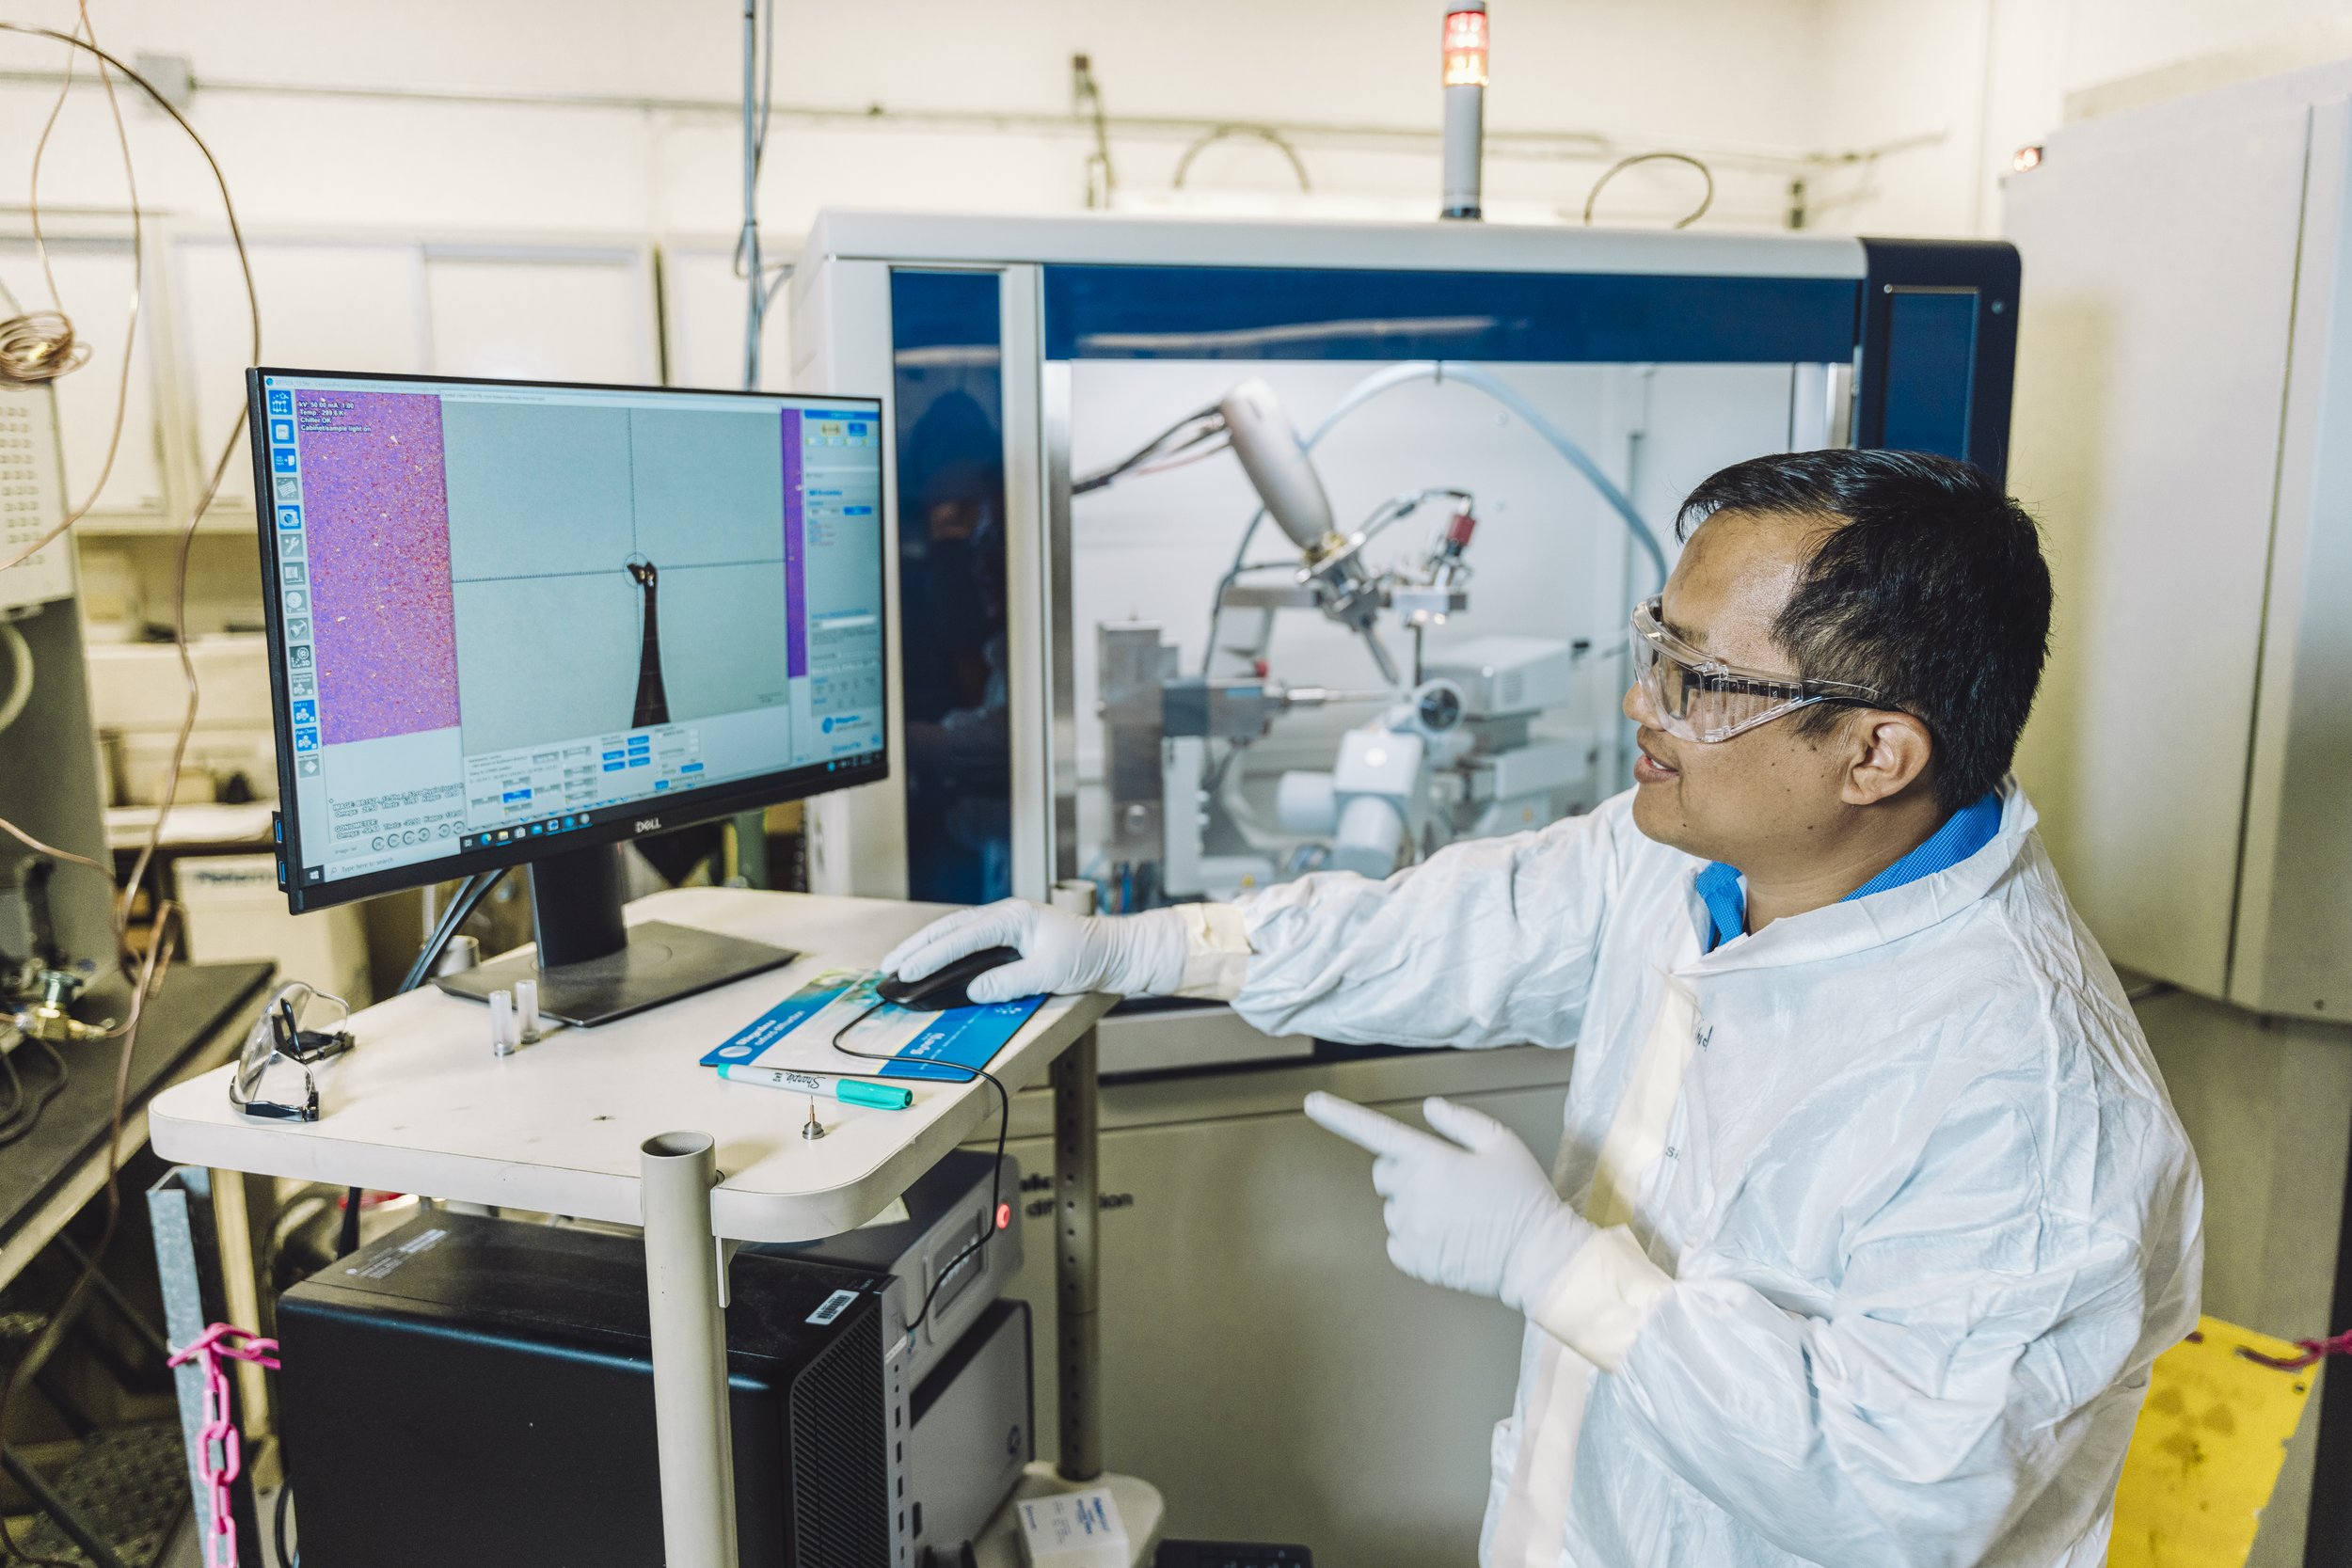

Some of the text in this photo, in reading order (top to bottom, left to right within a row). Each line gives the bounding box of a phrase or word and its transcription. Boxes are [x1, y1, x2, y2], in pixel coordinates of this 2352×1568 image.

[301, 424, 347, 433] Cabinet/sample
[333, 800, 356, 812] IMAGE:
[335, 809, 358, 818] Omega:
[634, 817, 661, 833] DELL
[336, 830, 359, 840] Omega:
[342, 865, 355, 874] Type
